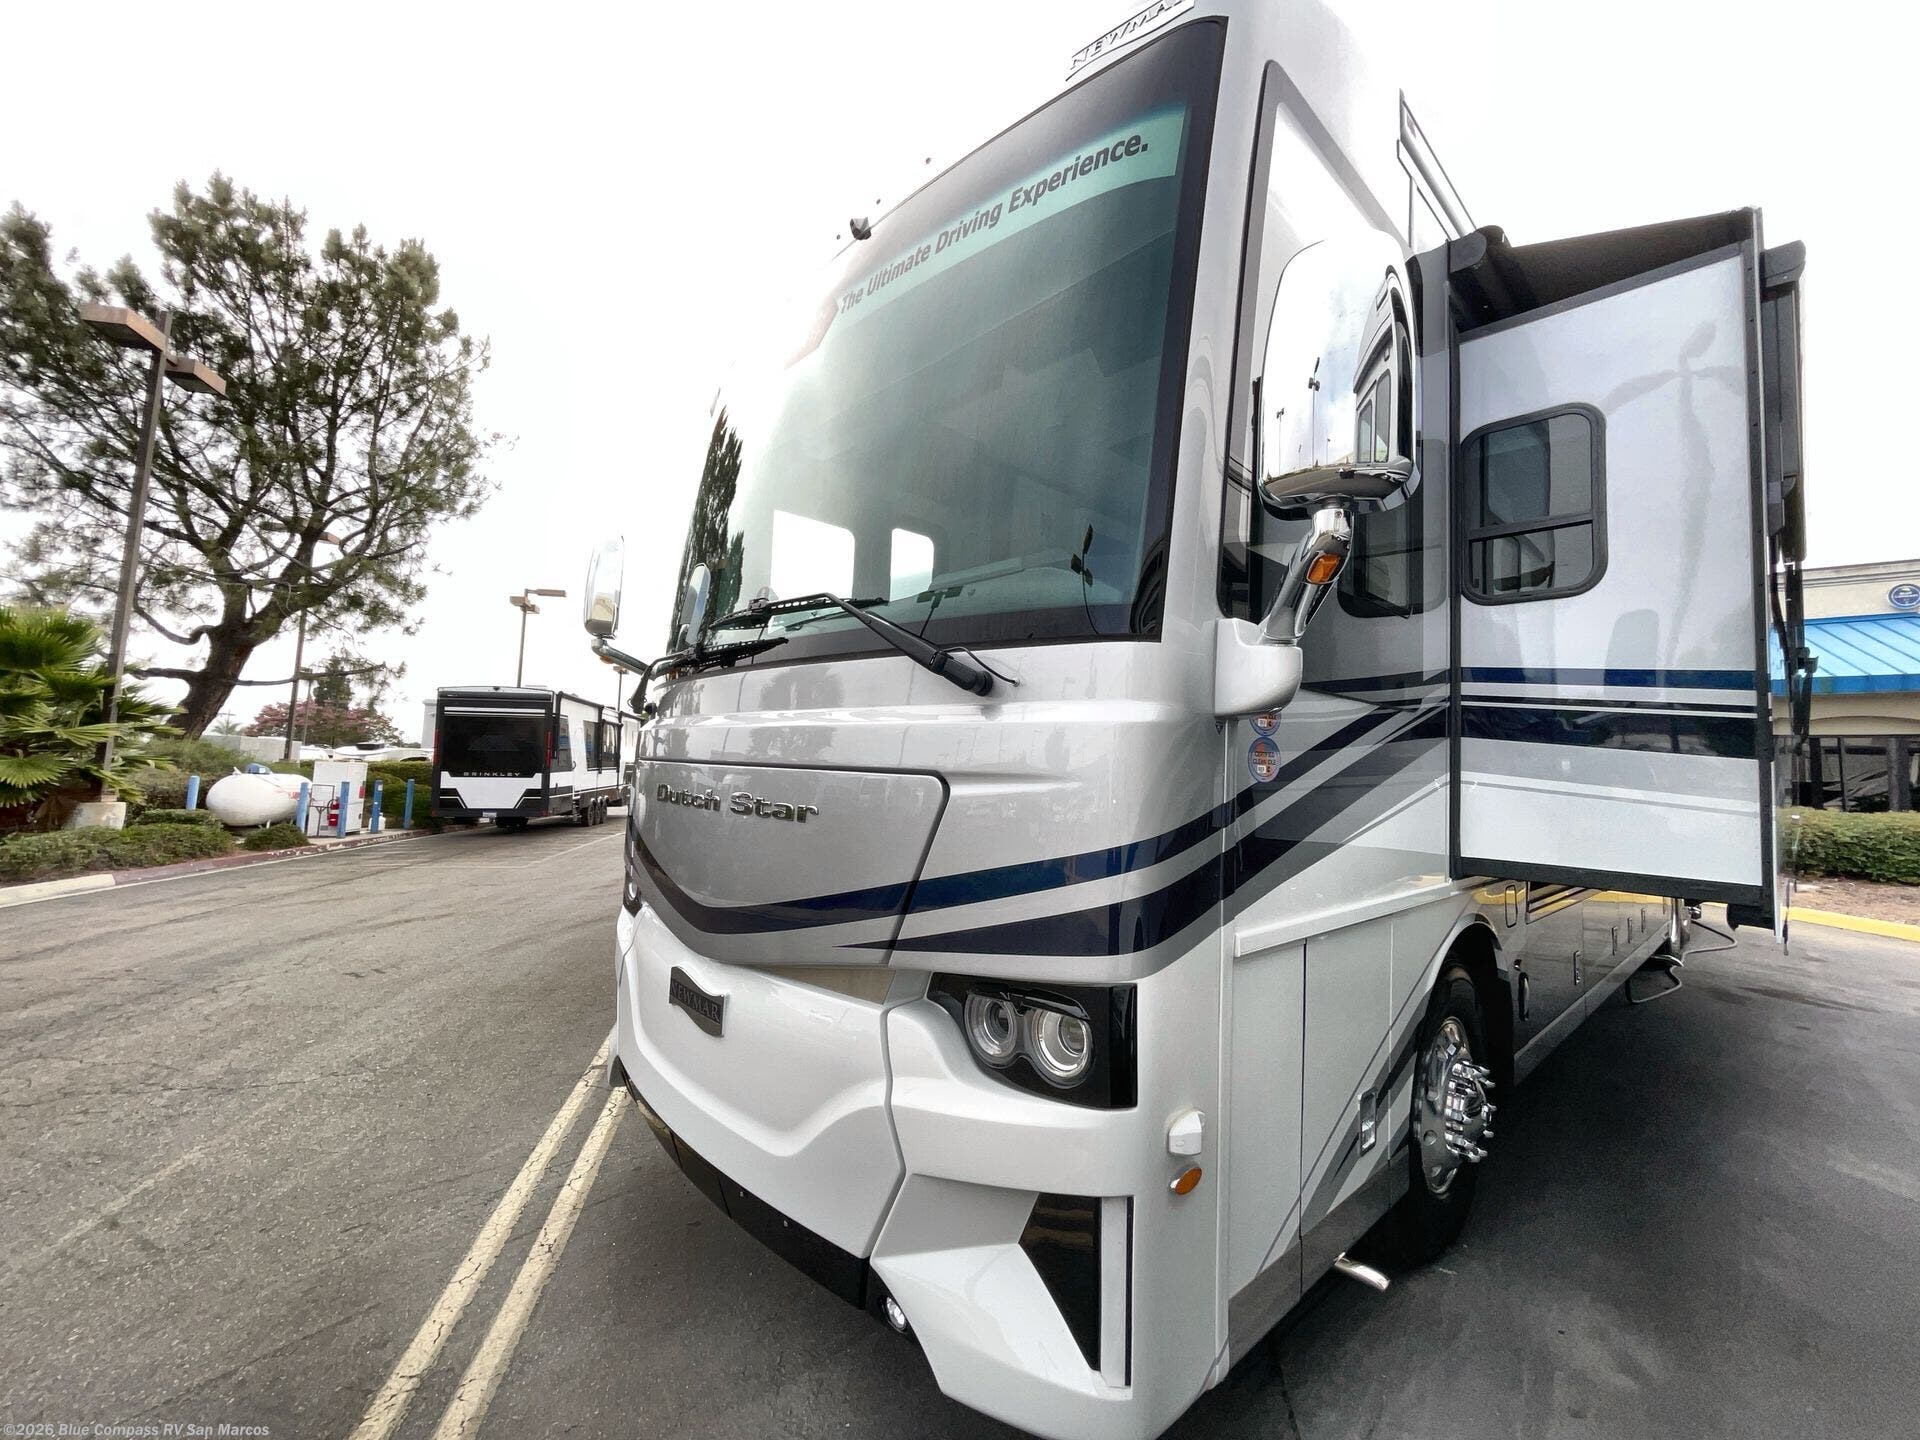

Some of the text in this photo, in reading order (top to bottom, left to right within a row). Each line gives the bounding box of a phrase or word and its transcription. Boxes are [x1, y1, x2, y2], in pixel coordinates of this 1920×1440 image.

[1070, 0, 1183, 70] NEWMA
[841, 133, 1150, 315] The Ultimate Driving Experience.
[656, 783, 820, 823] Dutch Star
[670, 980, 721, 1022] NEWMAR
